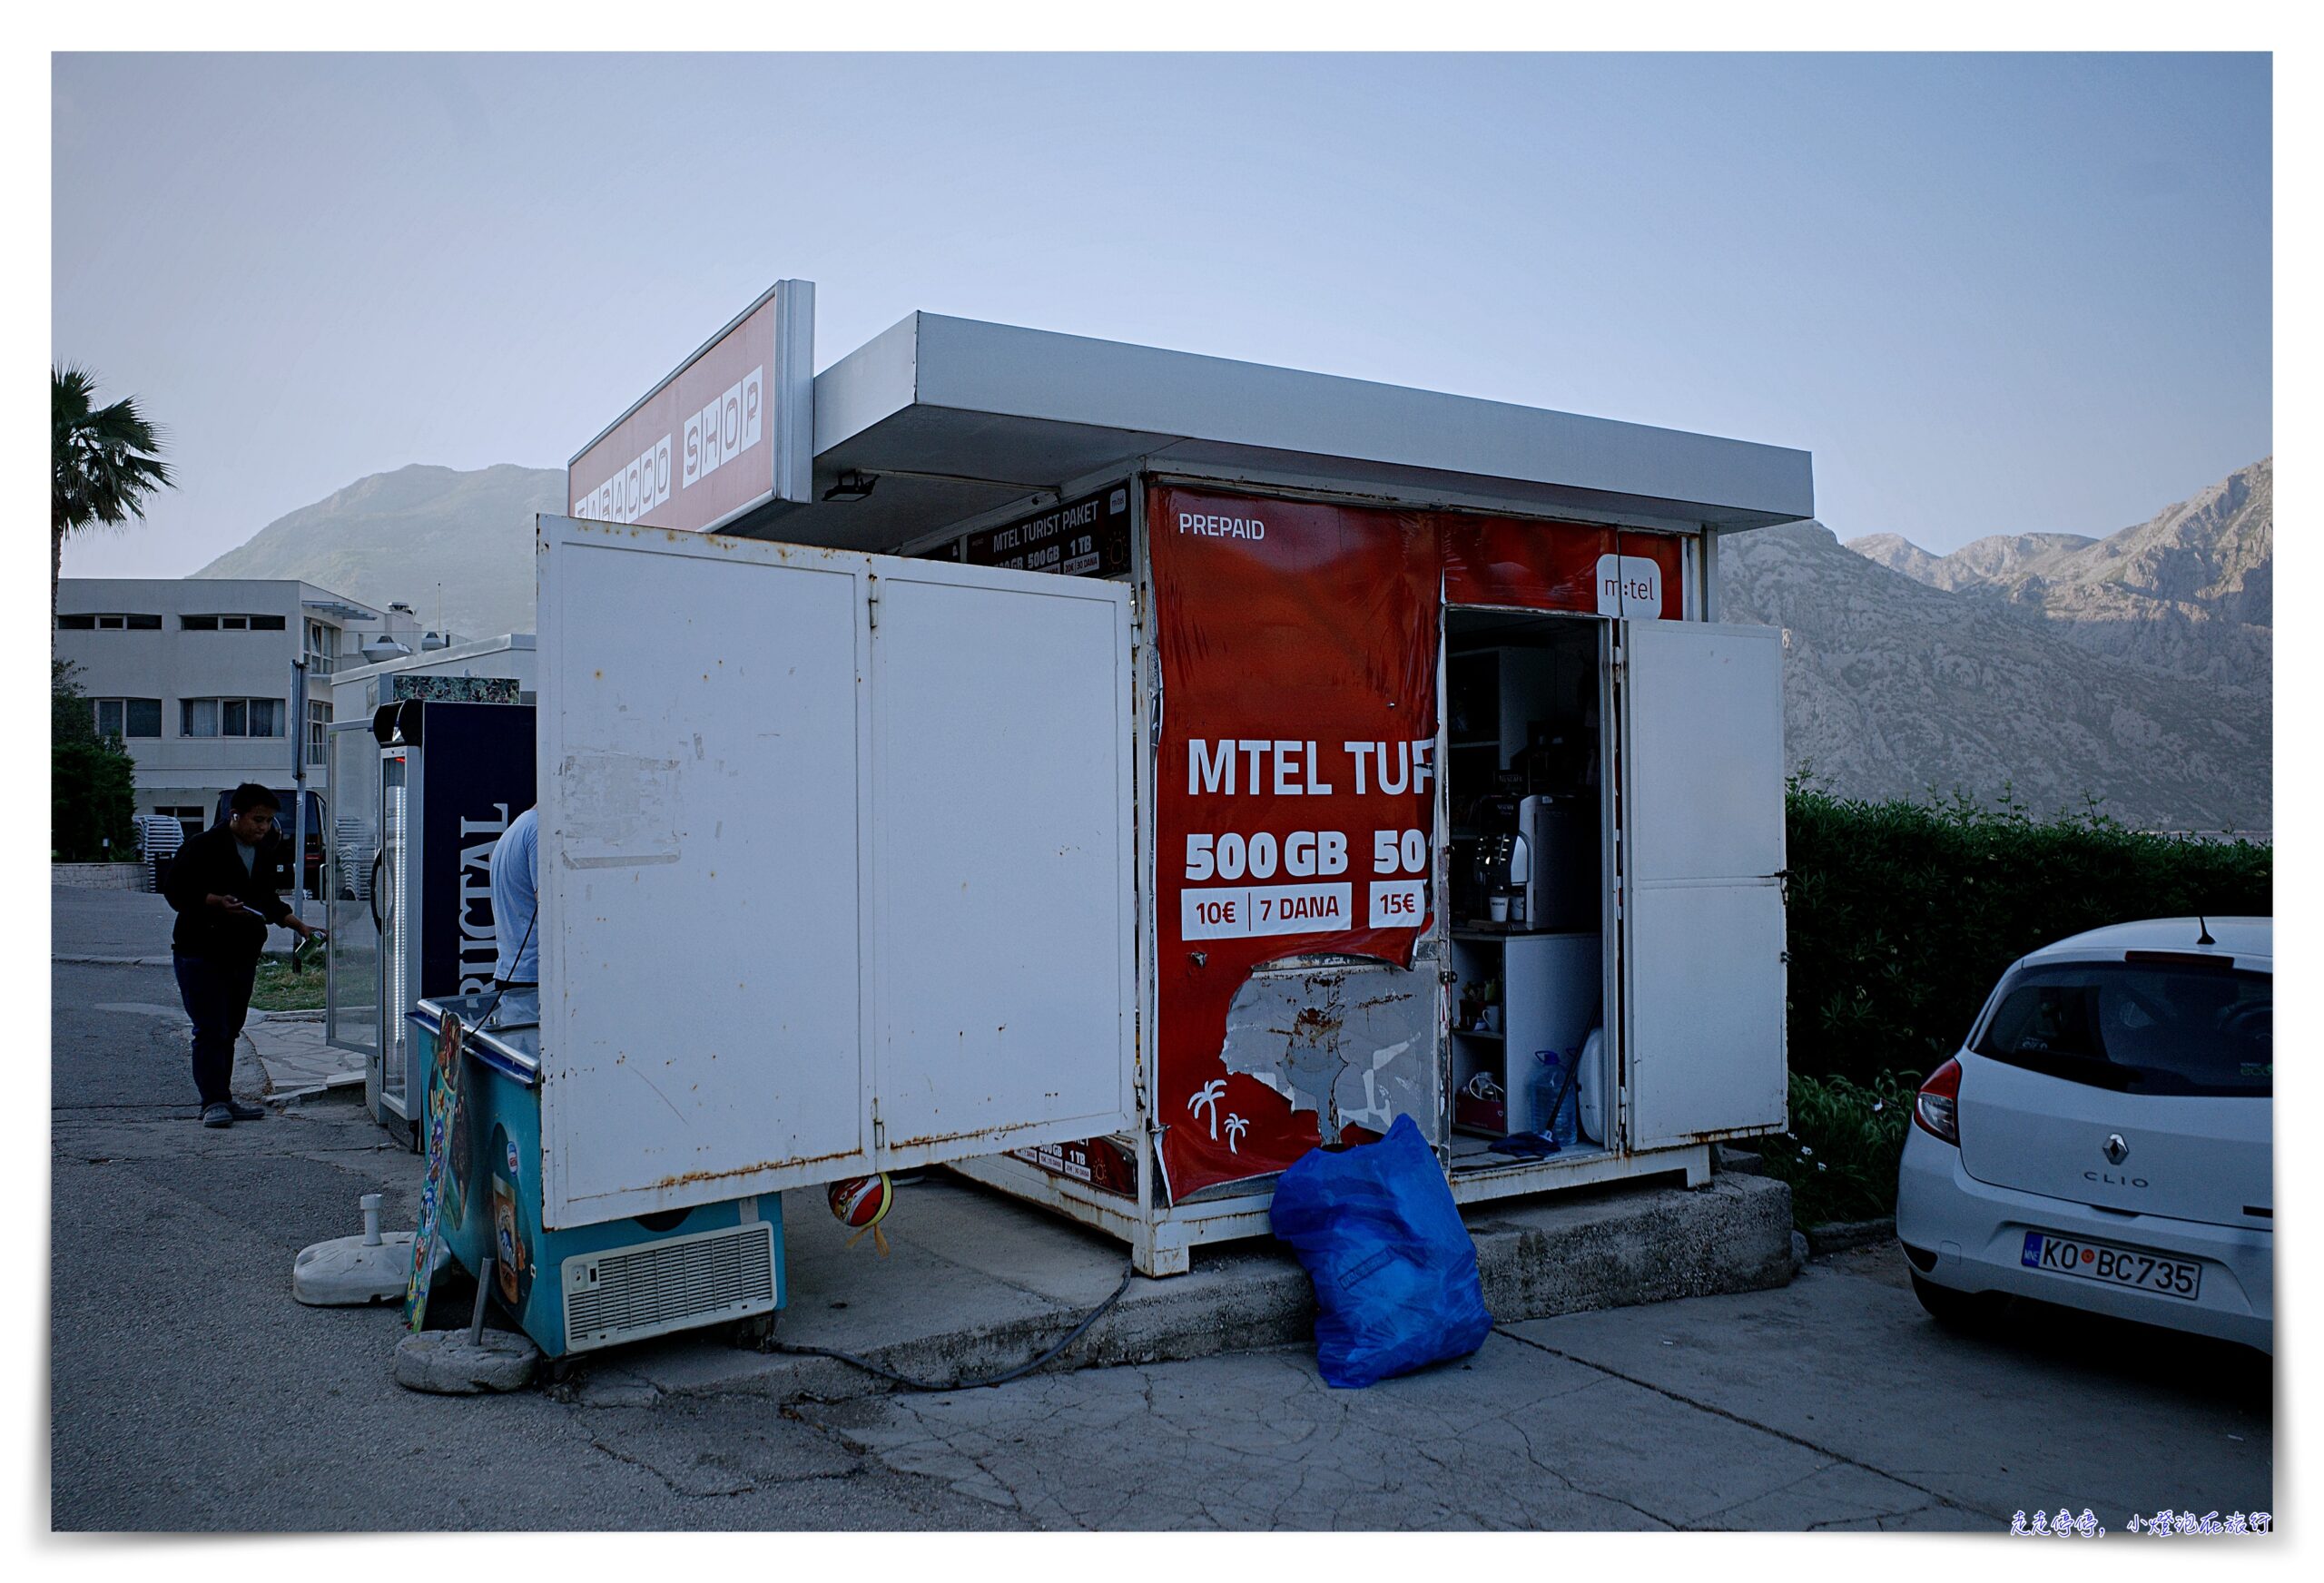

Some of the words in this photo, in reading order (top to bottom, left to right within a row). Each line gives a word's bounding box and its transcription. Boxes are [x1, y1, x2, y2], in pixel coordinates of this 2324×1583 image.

[686, 380, 759, 477] SHOP
[993, 527, 1021, 554] MTEL
[1021, 512, 1060, 545] TURIST
[1062, 499, 1100, 532] PAKET
[1179, 513, 1265, 540] PREPAID
[1604, 576, 1654, 601] m:tel
[1187, 738, 1333, 796] MTEL
[1185, 831, 1278, 881] 500
[1284, 830, 1349, 878] GB
[1373, 828, 1432, 874] 50
[1196, 901, 1236, 925] 10€
[1260, 900, 1272, 921] 7
[1279, 895, 1340, 920] DANA
[1380, 892, 1416, 915] 15€
[2084, 1171, 2149, 1188] CLIO
[2024, 1248, 2040, 1262] MNE
[2043, 1239, 2078, 1269] KO
[2097, 1249, 2195, 1293] BC735
